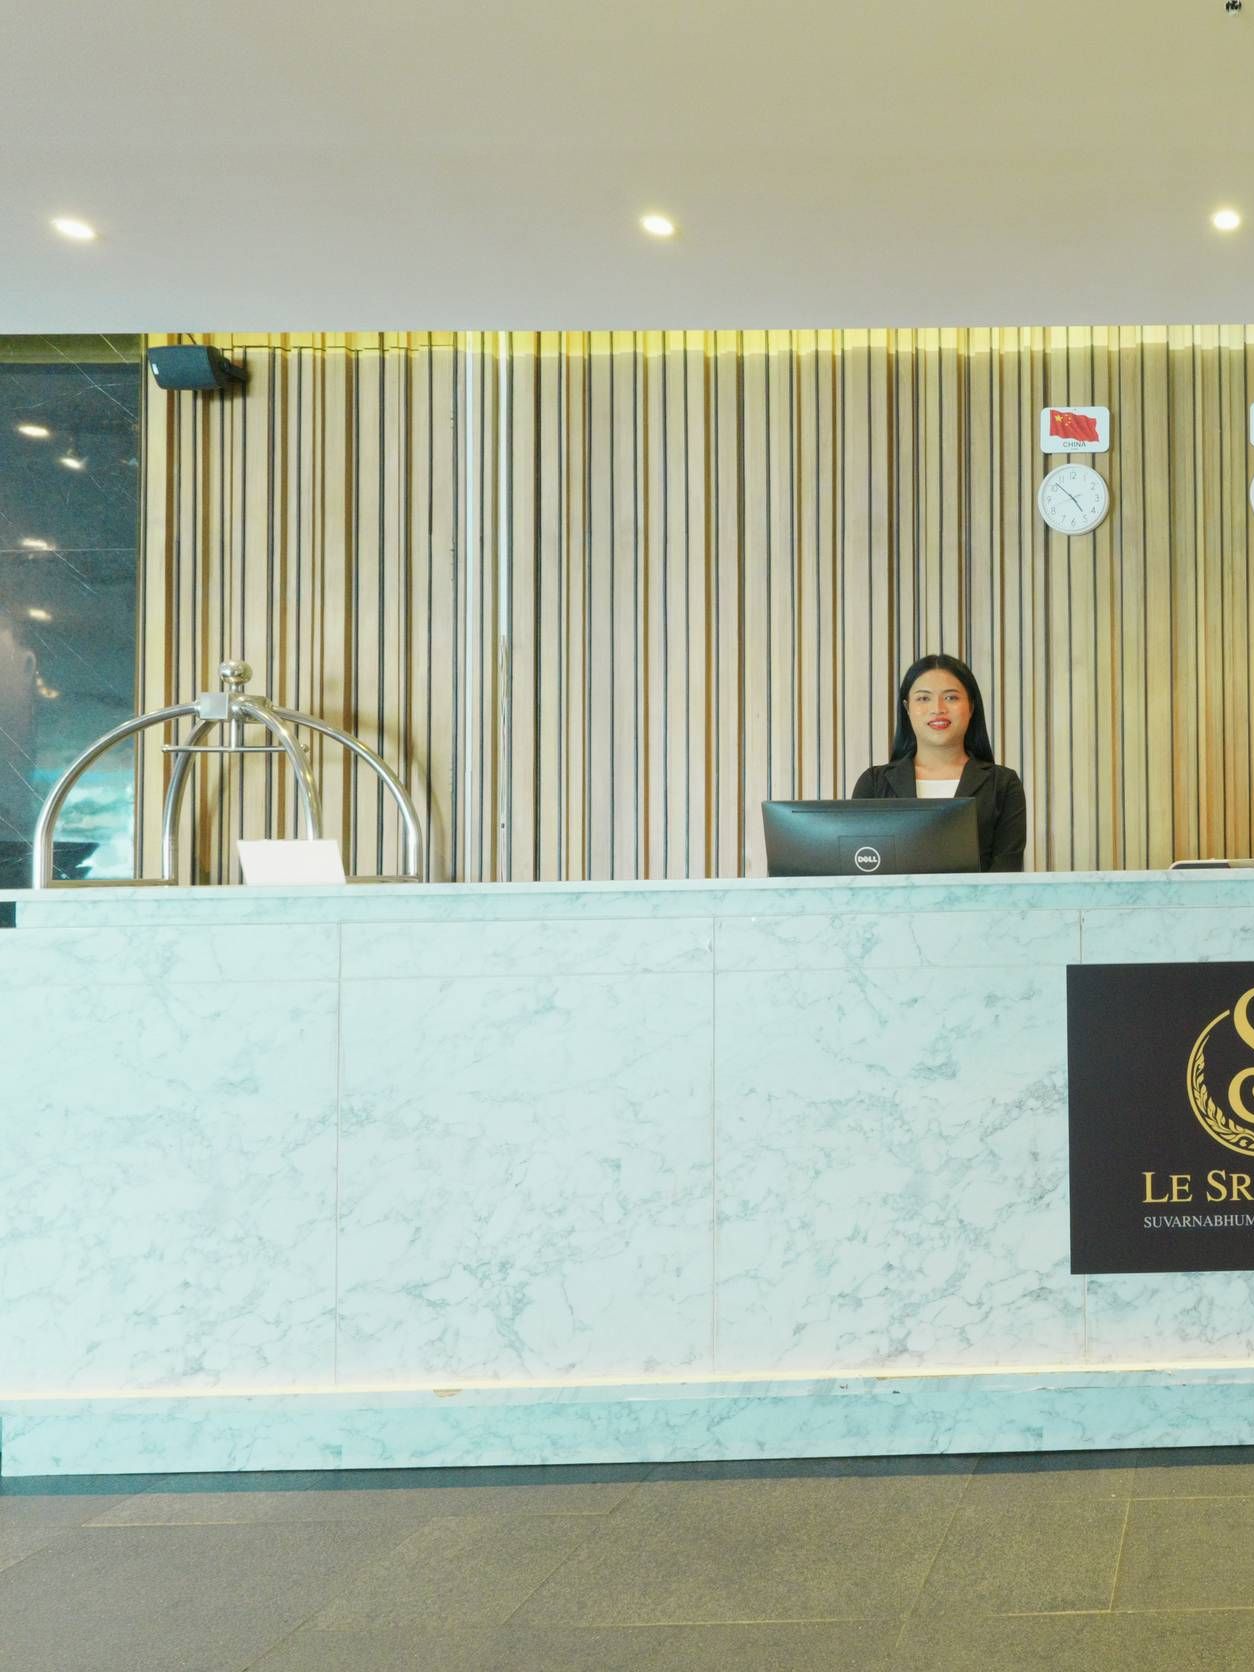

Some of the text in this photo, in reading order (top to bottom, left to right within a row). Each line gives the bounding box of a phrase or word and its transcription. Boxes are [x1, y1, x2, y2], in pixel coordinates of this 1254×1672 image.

[1070, 471, 1077, 480] 12
[857, 855, 878, 863] DELL
[1142, 1171, 1193, 1203] LE
